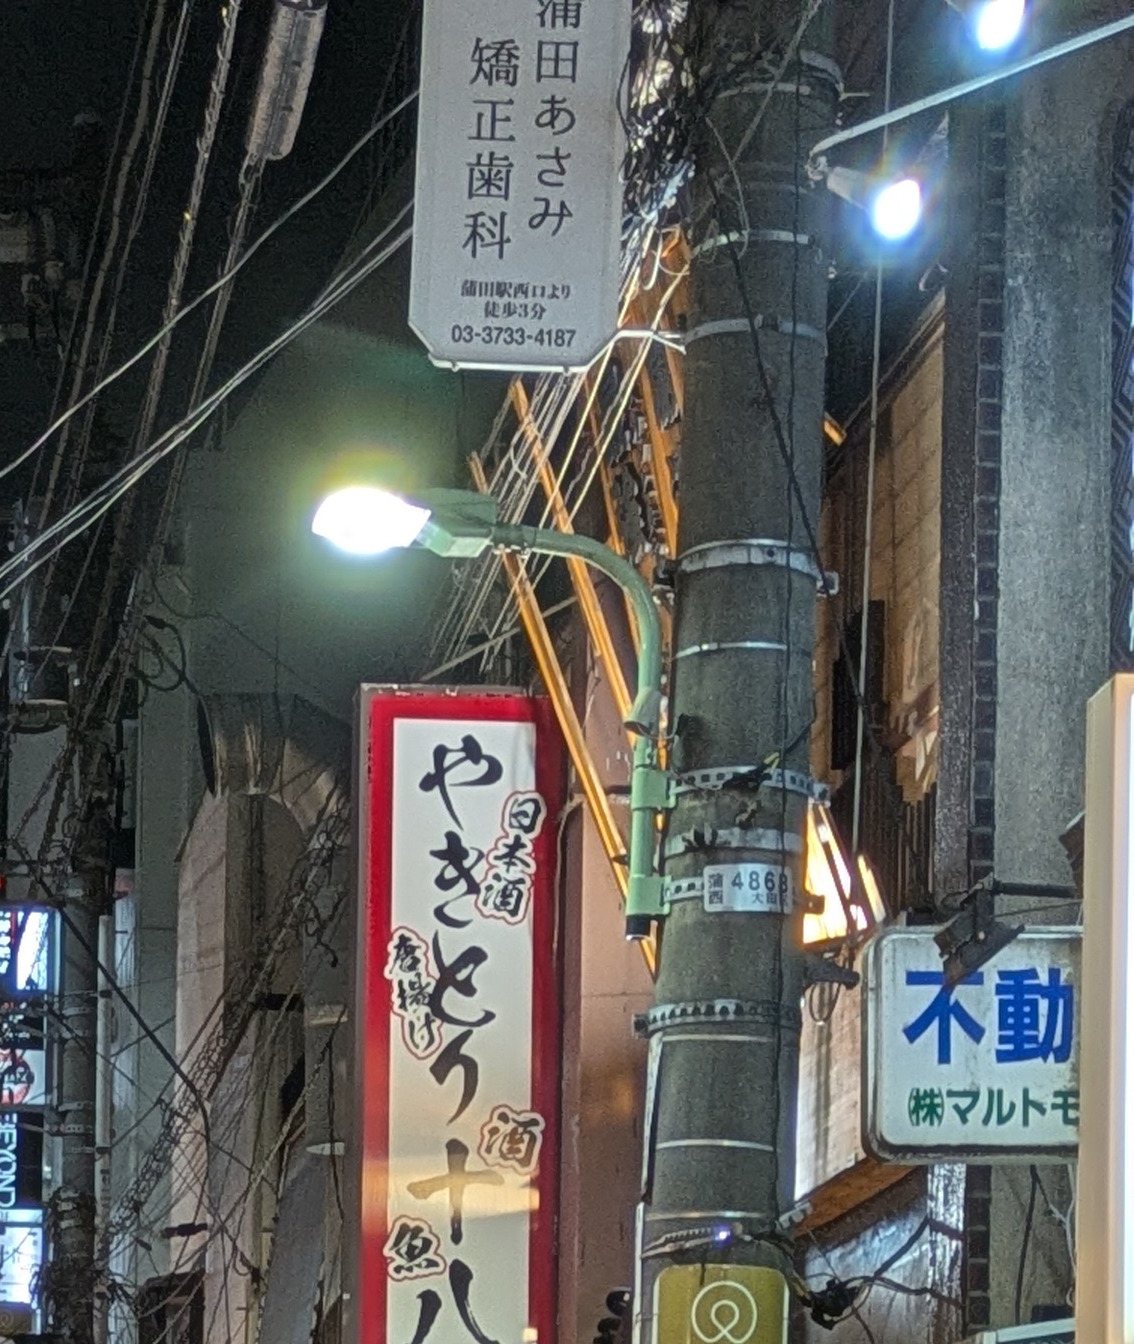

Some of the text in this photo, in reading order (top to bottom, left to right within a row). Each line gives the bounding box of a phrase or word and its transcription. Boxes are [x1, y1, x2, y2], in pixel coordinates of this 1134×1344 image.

[462, 37, 521, 260] 矯正歯科
[460, 279, 572, 300] 蒲田駅西口より
[484, 300, 547, 320] 徒歩3分
[451, 324, 577, 348] 03-3733-4187
[482, 798, 543, 918] 日本酒
[389, 933, 437, 1052] 唐揚げ
[484, 1112, 542, 1167] 酒
[389, 1221, 439, 1273] 魚
